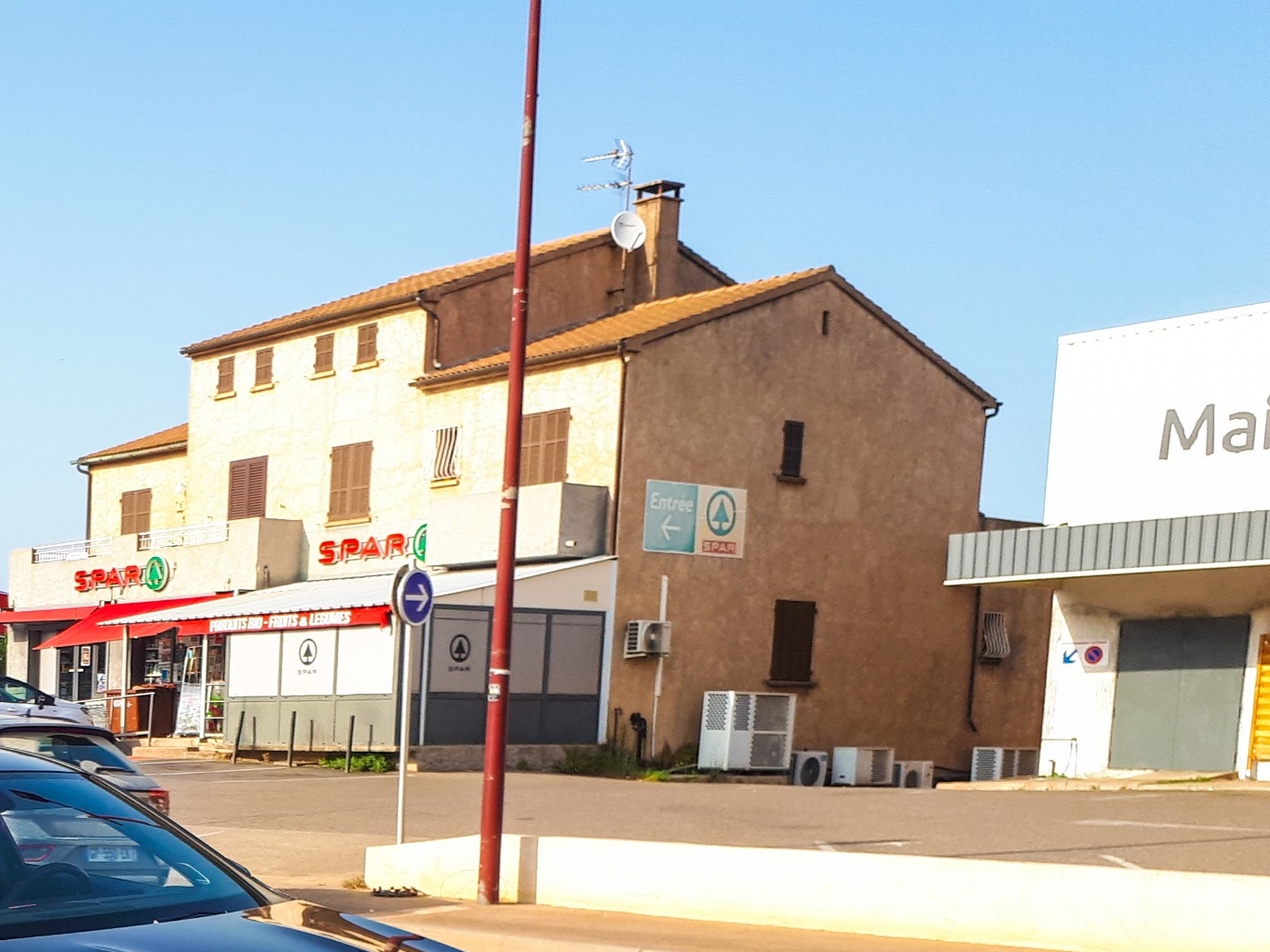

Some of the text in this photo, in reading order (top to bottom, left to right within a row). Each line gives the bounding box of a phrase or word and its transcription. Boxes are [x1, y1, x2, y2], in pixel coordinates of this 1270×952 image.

[650, 492, 694, 513] Entrée
[318, 533, 405, 564] SPAR
[702, 541, 736, 554] SPAR
[74, 565, 141, 591] SPAR
[209, 617, 248, 633] PRODUITS
[247, 616, 264, 630] BIO
[268, 614, 299, 629] FRUITS
[299, 616, 308, 627] &
